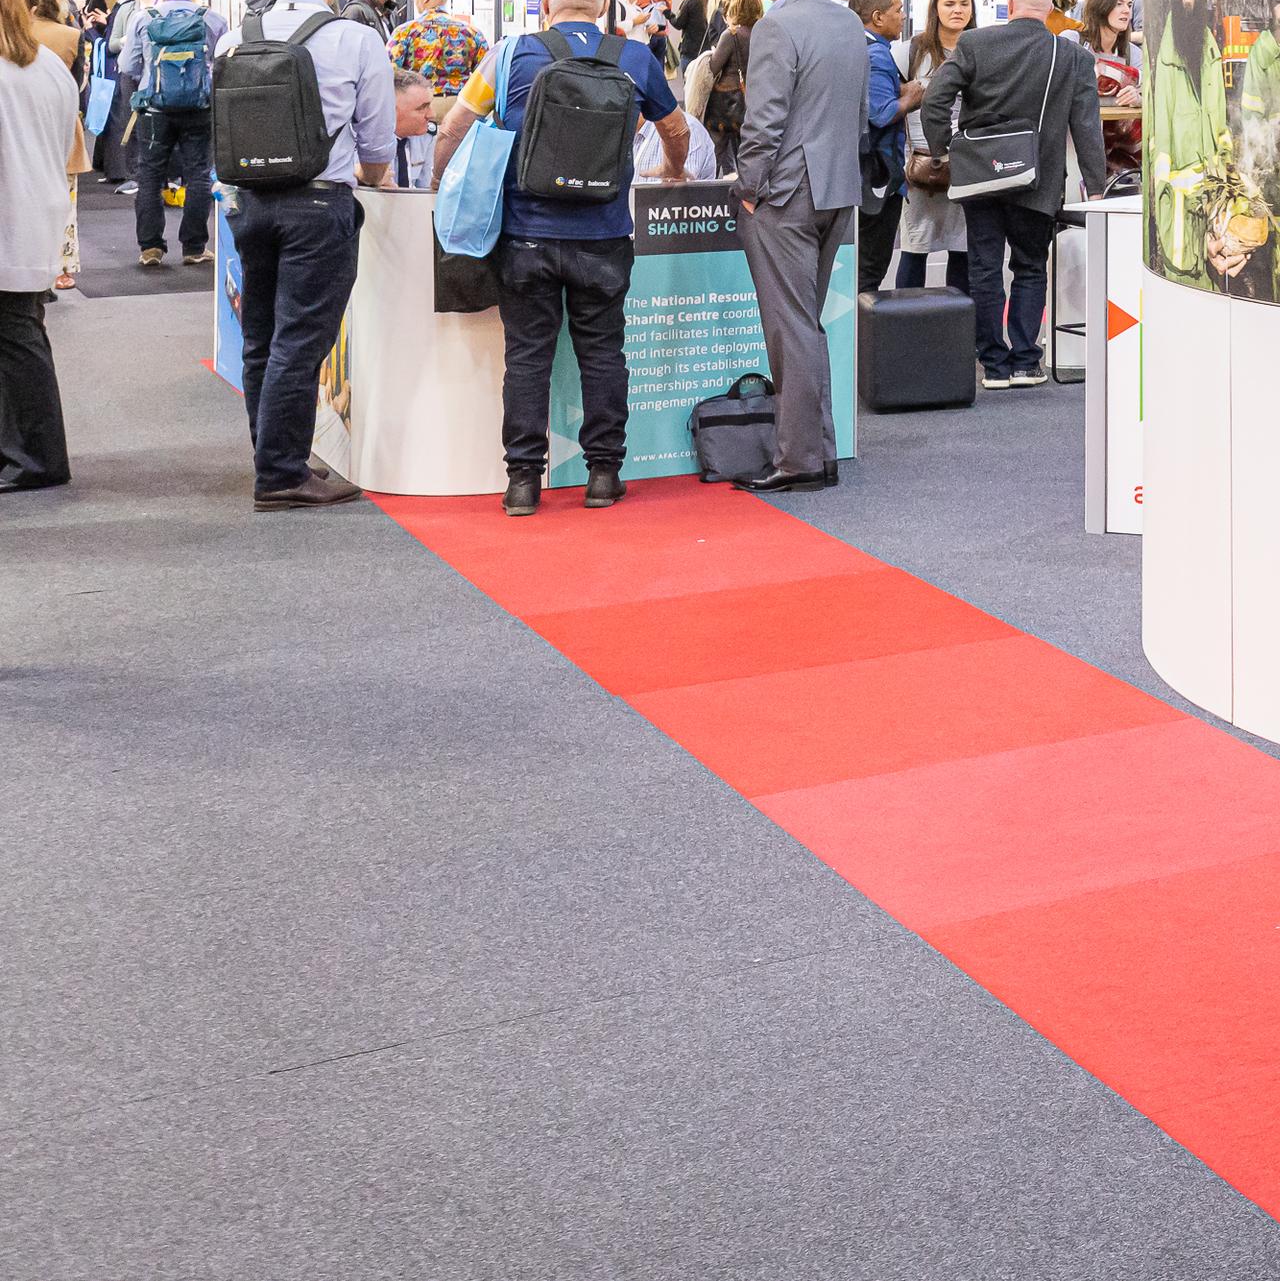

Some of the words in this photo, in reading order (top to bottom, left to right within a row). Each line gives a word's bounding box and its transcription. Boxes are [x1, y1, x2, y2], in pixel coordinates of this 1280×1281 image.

[648, 204, 731, 221] NATIONAL
[648, 221, 719, 236] SHARING
[626, 298, 648, 308] The
[651, 294, 705, 307] National
[625, 313, 674, 326] Sharing
[678, 311, 719, 321] Centre
[625, 331, 646, 343] and
[651, 327, 709, 341] facilitates
[625, 348, 646, 360] and
[650, 345, 707, 358] interstate
[675, 361, 690, 373] its
[693, 357, 760, 371] established
[702, 375, 723, 387] and
